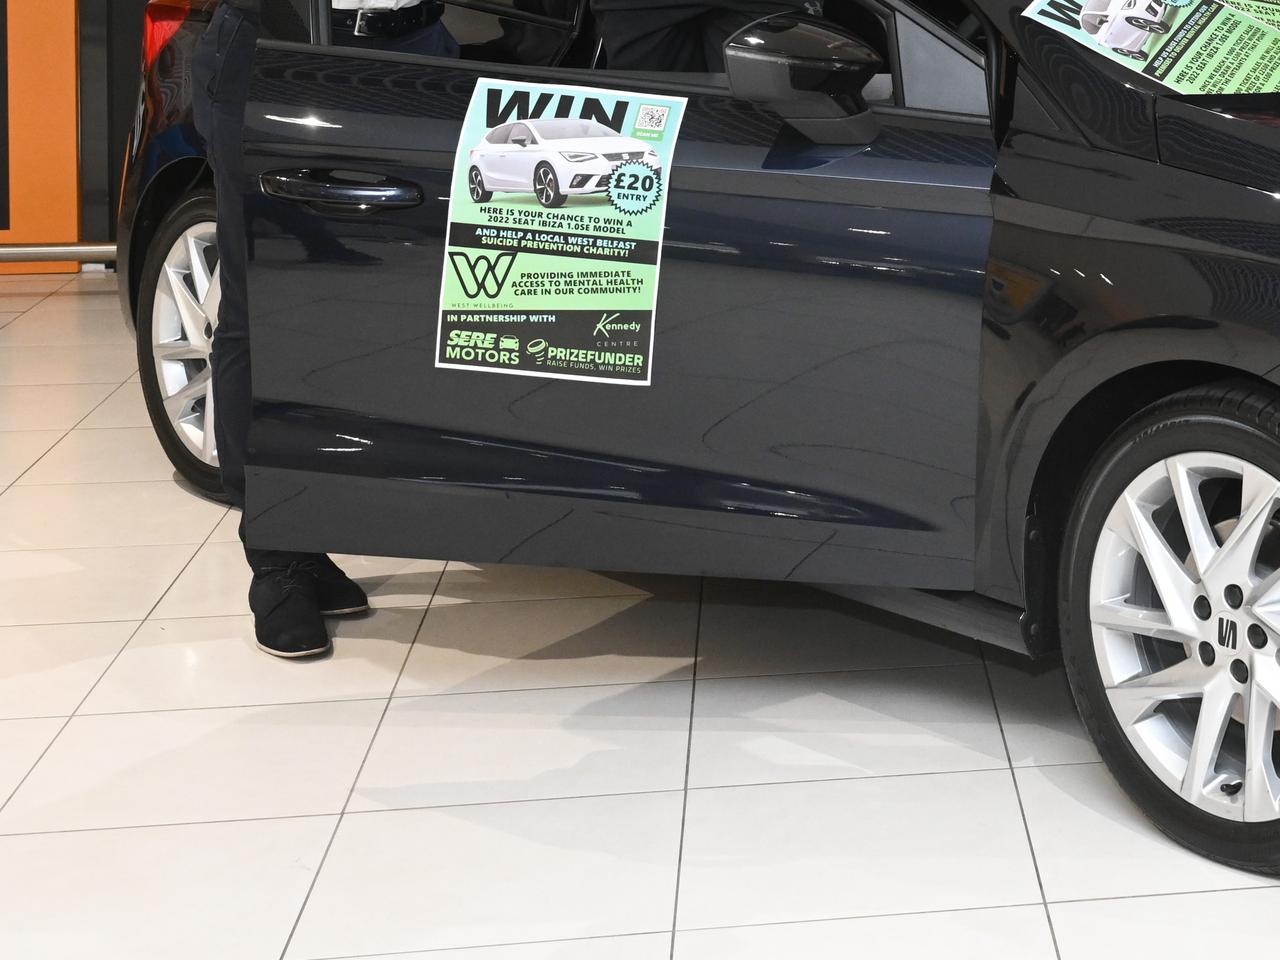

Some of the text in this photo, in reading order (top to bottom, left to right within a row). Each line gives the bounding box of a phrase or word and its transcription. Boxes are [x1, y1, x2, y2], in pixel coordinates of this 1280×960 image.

[1175, 70, 1190, 85] HERE
[1190, 51, 1205, 66] YOUR
[1200, 32, 1220, 53] CHANCE
[1216, 25, 1225, 33] TO
[1221, 16, 1233, 27] WIN
[1187, 70, 1201, 84] 2022
[1196, 58, 1210, 72] SEAT
[1206, 45, 1220, 60] IBIZA
[1225, 18, 1241, 35] MODEL
[486, 88, 629, 133] WIN
[614, 172, 654, 192] £20
[616, 192, 648, 202] ENTRY
[479, 205, 633, 227] HERE IS YOUR CHANCE TO WIN A
[487, 215, 509, 223] 2022
[512, 217, 535, 226] SEAT
[538, 220, 564, 229] IBIZA
[592, 225, 626, 234] MODEL
[475, 227, 636, 250] AND HELP A LOCAL WEST BELFAST
[480, 236, 629, 257] SUICIDE PREVENTION CHARITY!
[511, 278, 643, 288] ACCESS TO MENTAL HEALTH
[520, 270, 632, 280] PROVIDING IMMEDIATE
[514, 286, 641, 296] CARE IN OUR COMMUNITY!
[447, 314, 556, 322] IN PARTNERSHIP WITH
[593, 313, 641, 338] Kennedy
[447, 330, 497, 349] SERE
[446, 347, 519, 364] MOTORS
[548, 346, 643, 366] PRIZEFUNDER
[546, 360, 567, 368] RAISE
[598, 364, 613, 372] WIN
[615, 365, 641, 374] PRIZES
